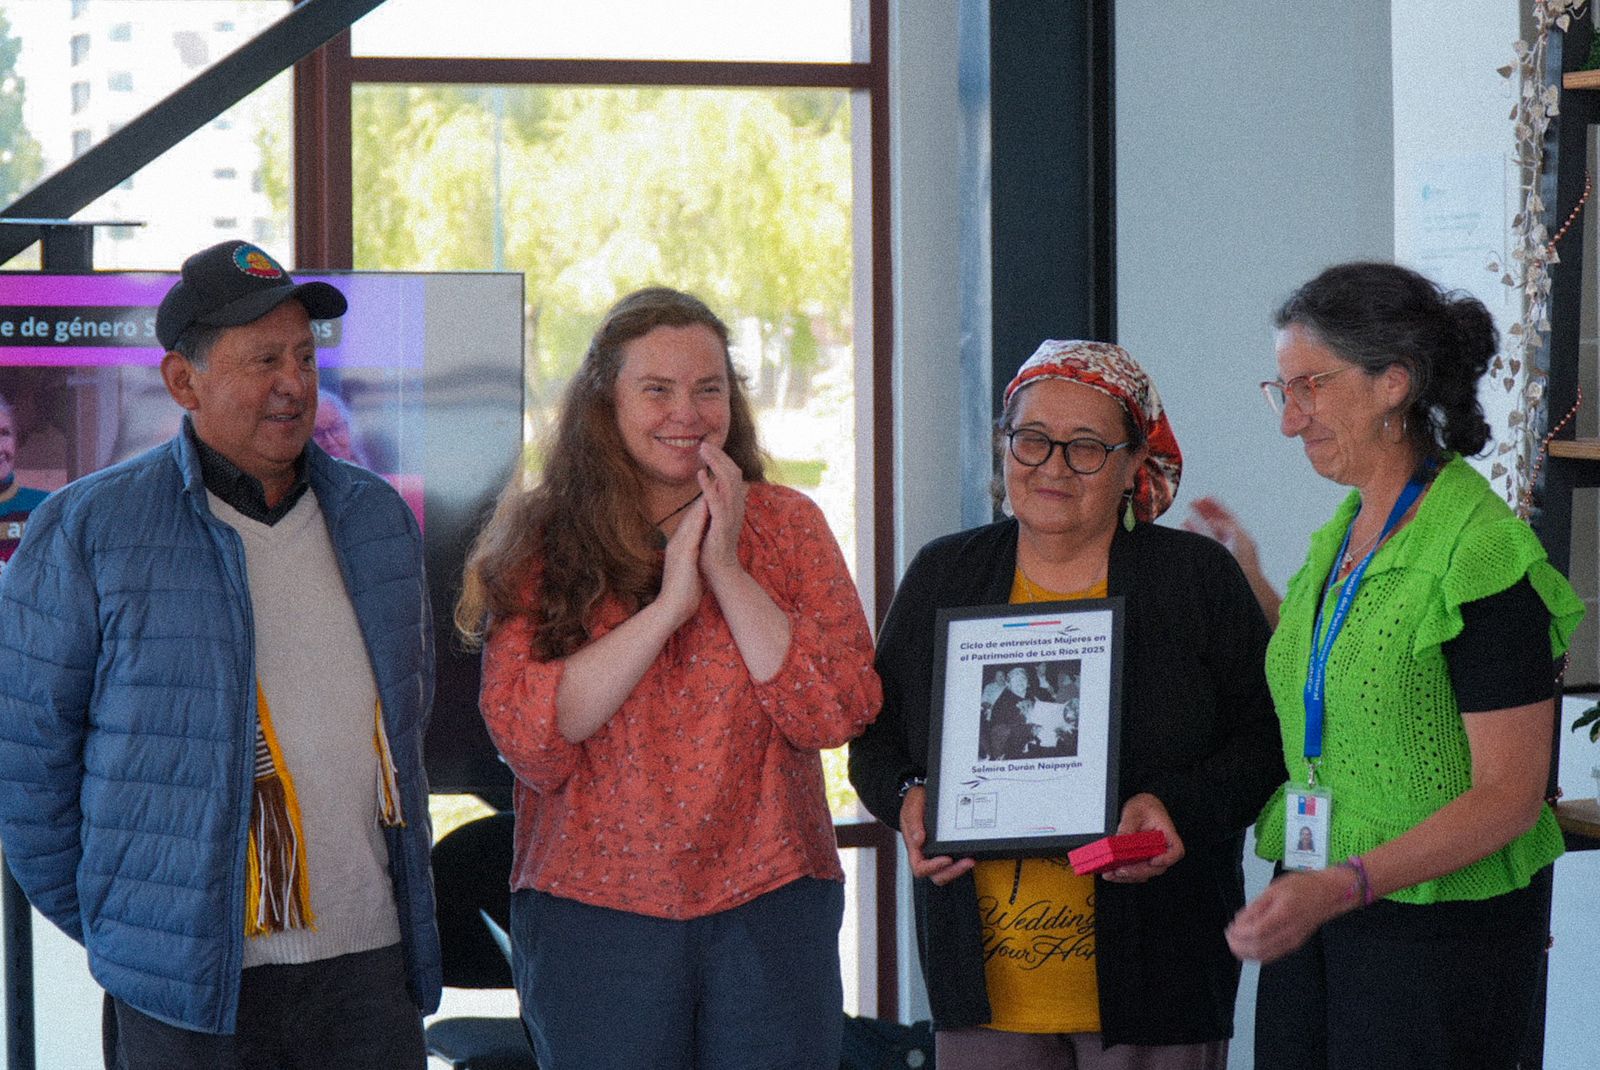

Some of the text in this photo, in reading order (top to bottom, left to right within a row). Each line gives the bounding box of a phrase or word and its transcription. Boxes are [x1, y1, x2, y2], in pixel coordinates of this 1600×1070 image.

[20, 316, 49, 337] de
[54, 316, 137, 342] género
[960, 641, 984, 650] Ciclo
[985, 641, 998, 649] de
[1000, 638, 1052, 648] entrevistas
[1054, 635, 1092, 645] Mujeres
[960, 653, 969, 661] el
[971, 651, 1024, 661] Patrimonio
[1026, 650, 1038, 658] de
[1040, 649, 1056, 657] Los
[1081, 645, 1105, 655] 2025
[979, 896, 1095, 935] Wedding
